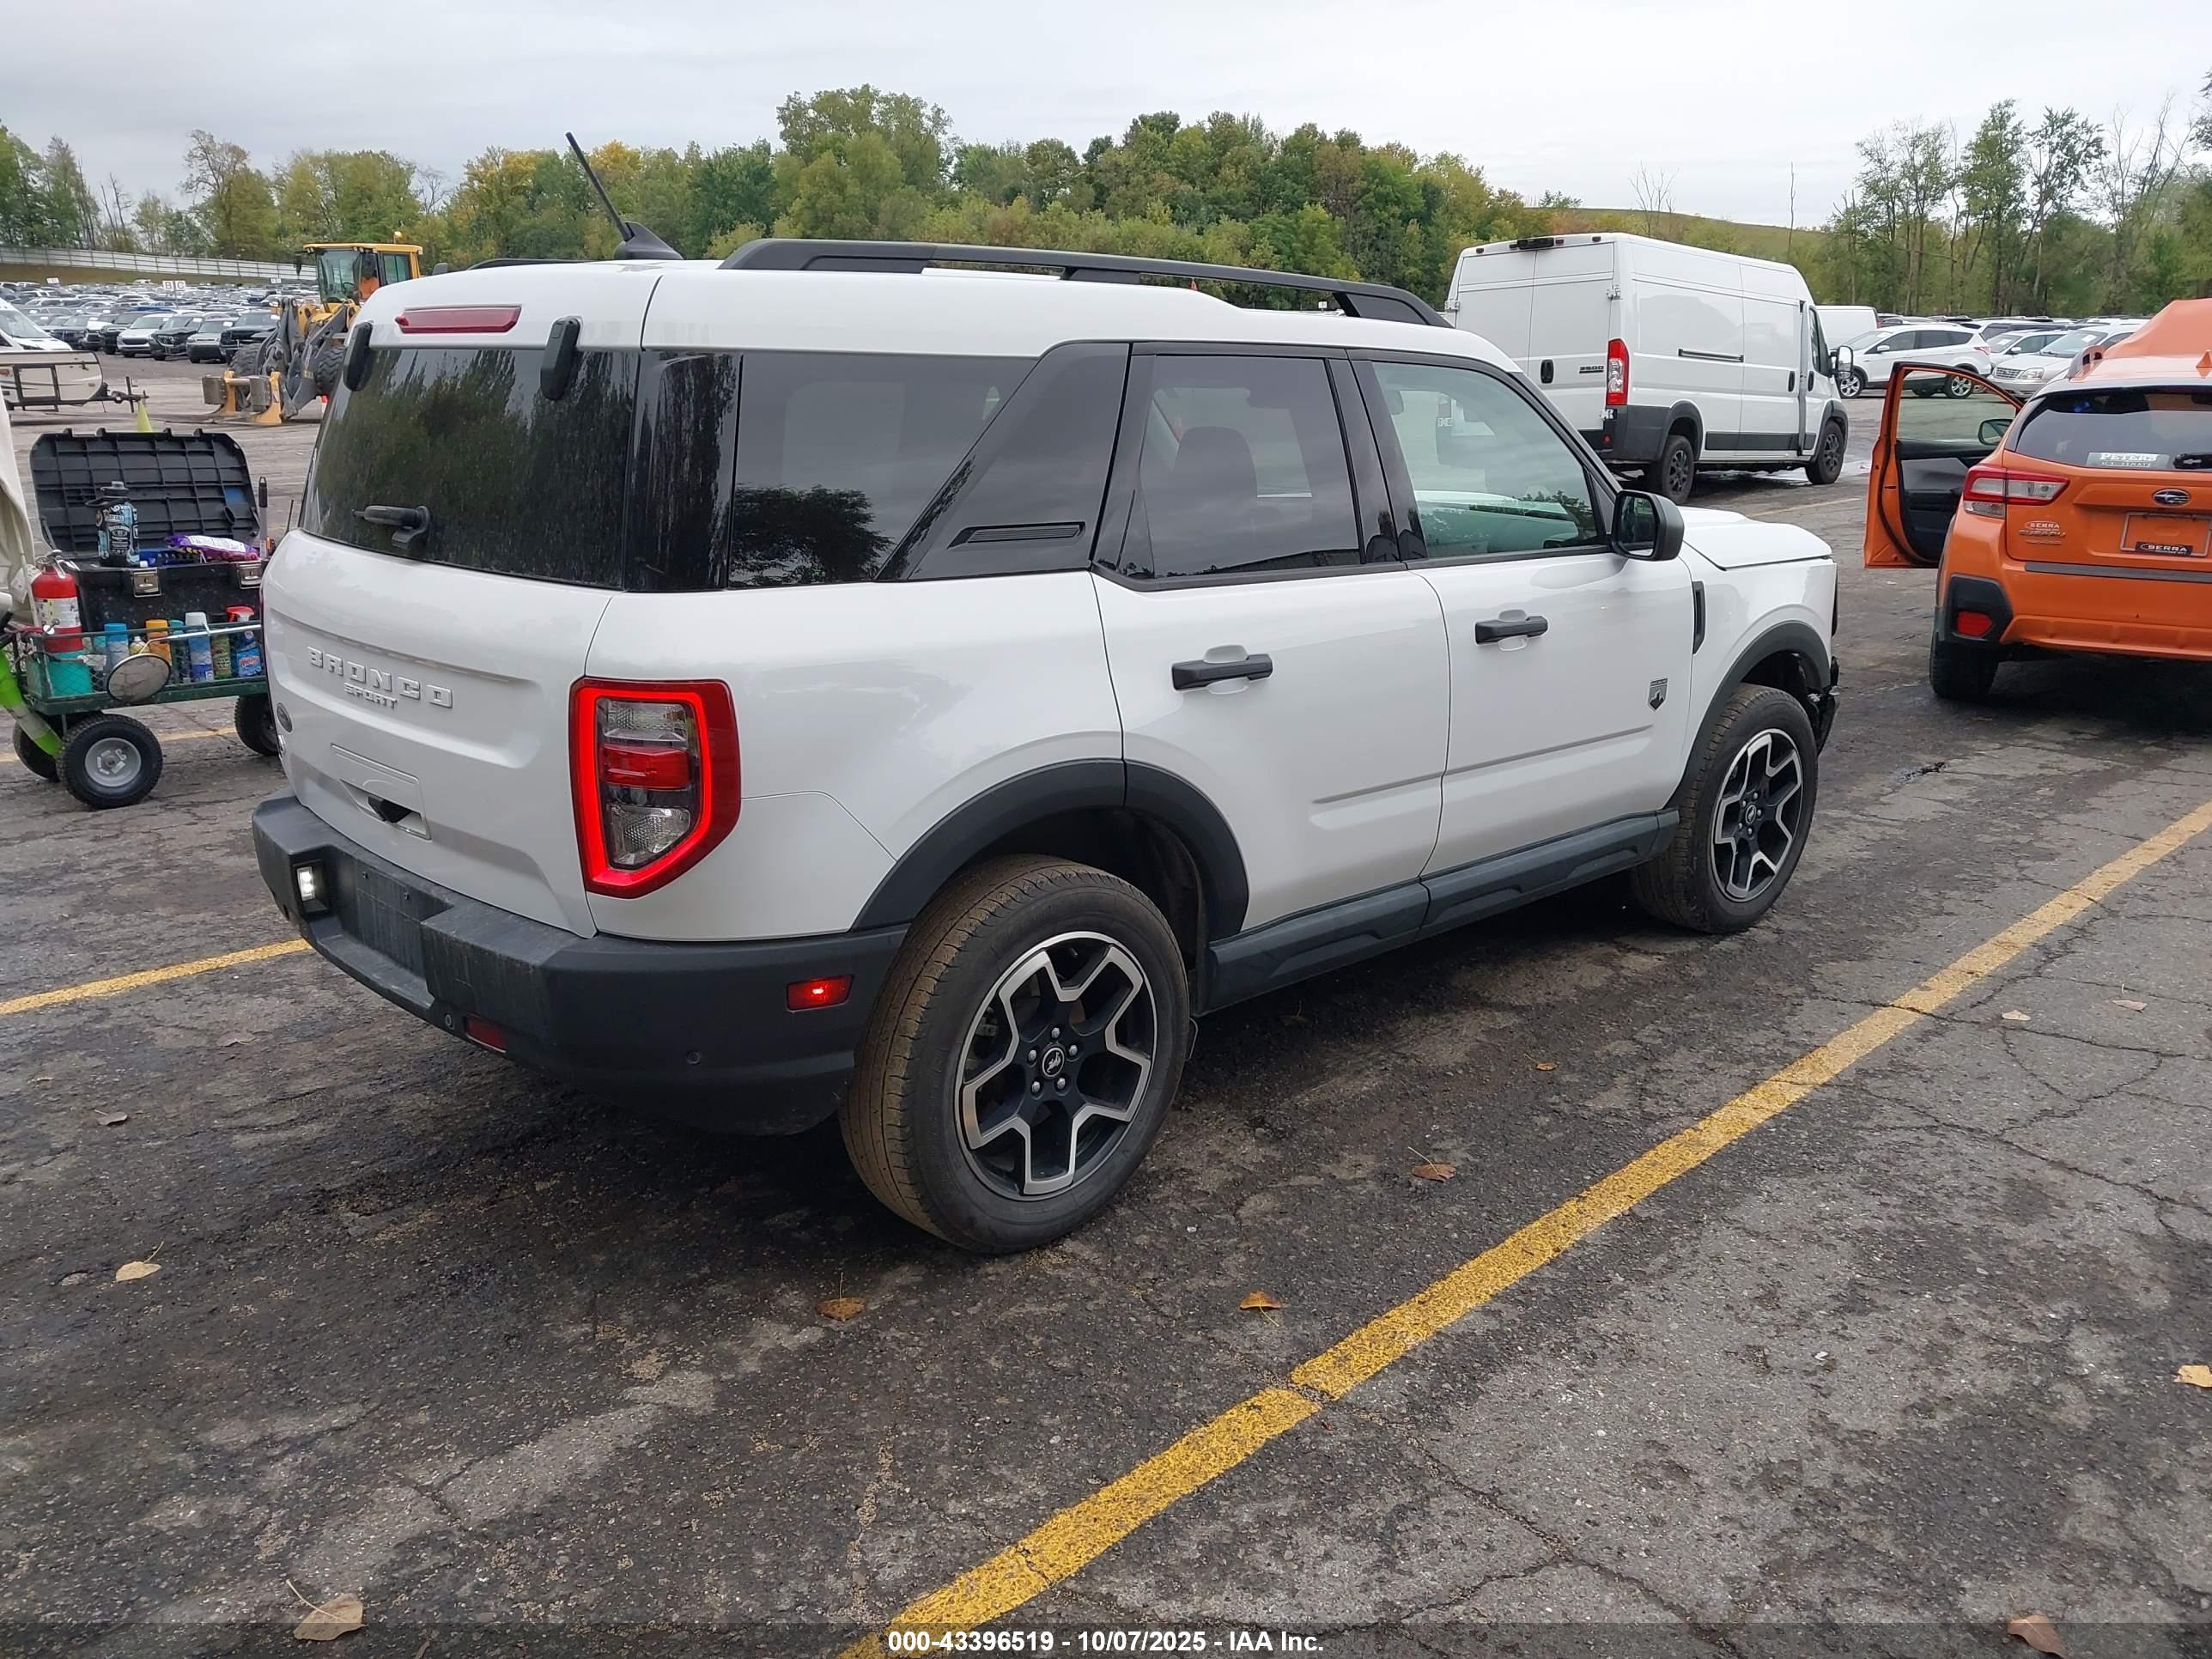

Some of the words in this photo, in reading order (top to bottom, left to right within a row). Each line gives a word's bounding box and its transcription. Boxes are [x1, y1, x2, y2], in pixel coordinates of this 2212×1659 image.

[2100, 453, 2158, 462] PETERS
[307, 646, 453, 708] BRONCO
[343, 682, 398, 708] SPORT
